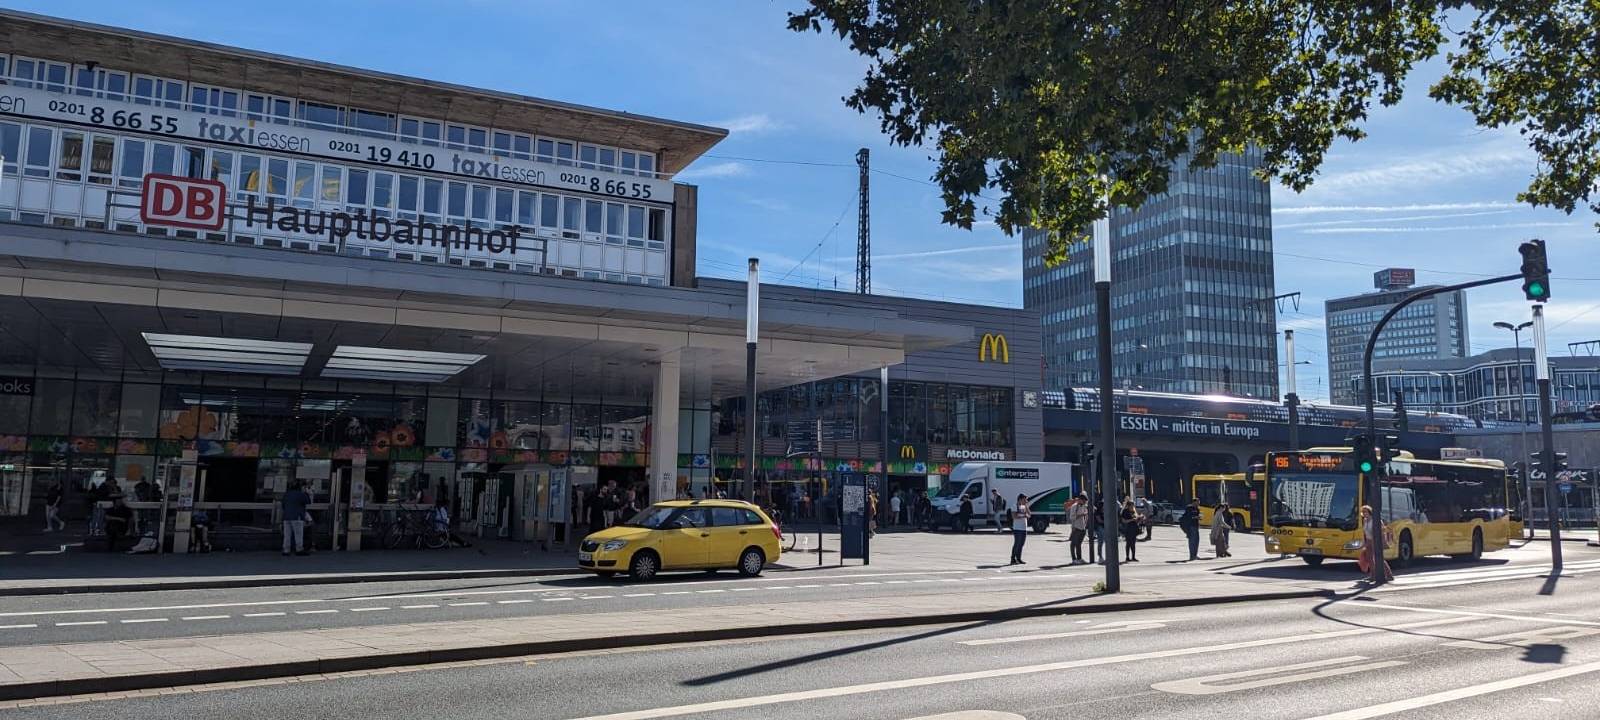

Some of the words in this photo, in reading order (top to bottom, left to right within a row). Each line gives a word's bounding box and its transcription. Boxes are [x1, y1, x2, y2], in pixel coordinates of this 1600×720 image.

[48, 100, 86, 116] 0201
[90, 106, 105, 124] 8
[112, 110, 142, 129] 66
[150, 115, 178, 134] 55
[329, 140, 360, 154] 0201
[367, 145, 391, 163] 19
[396, 151, 435, 169] 410
[560, 172, 587, 185] 0201
[589, 176, 600, 192] 8
[605, 179, 626, 195] 66
[631, 183, 652, 199] 55
[151, 182, 215, 221] DB
[246, 196, 521, 255] Hauptbahnhof
[1120, 416, 1158, 431] ESSEN
[1172, 420, 1207, 434] mitten
[1211, 422, 1221, 434] in
[1224, 422, 1260, 439] Europa
[947, 449, 1005, 460] McDonald's
[998, 469, 1039, 479] enterprise
